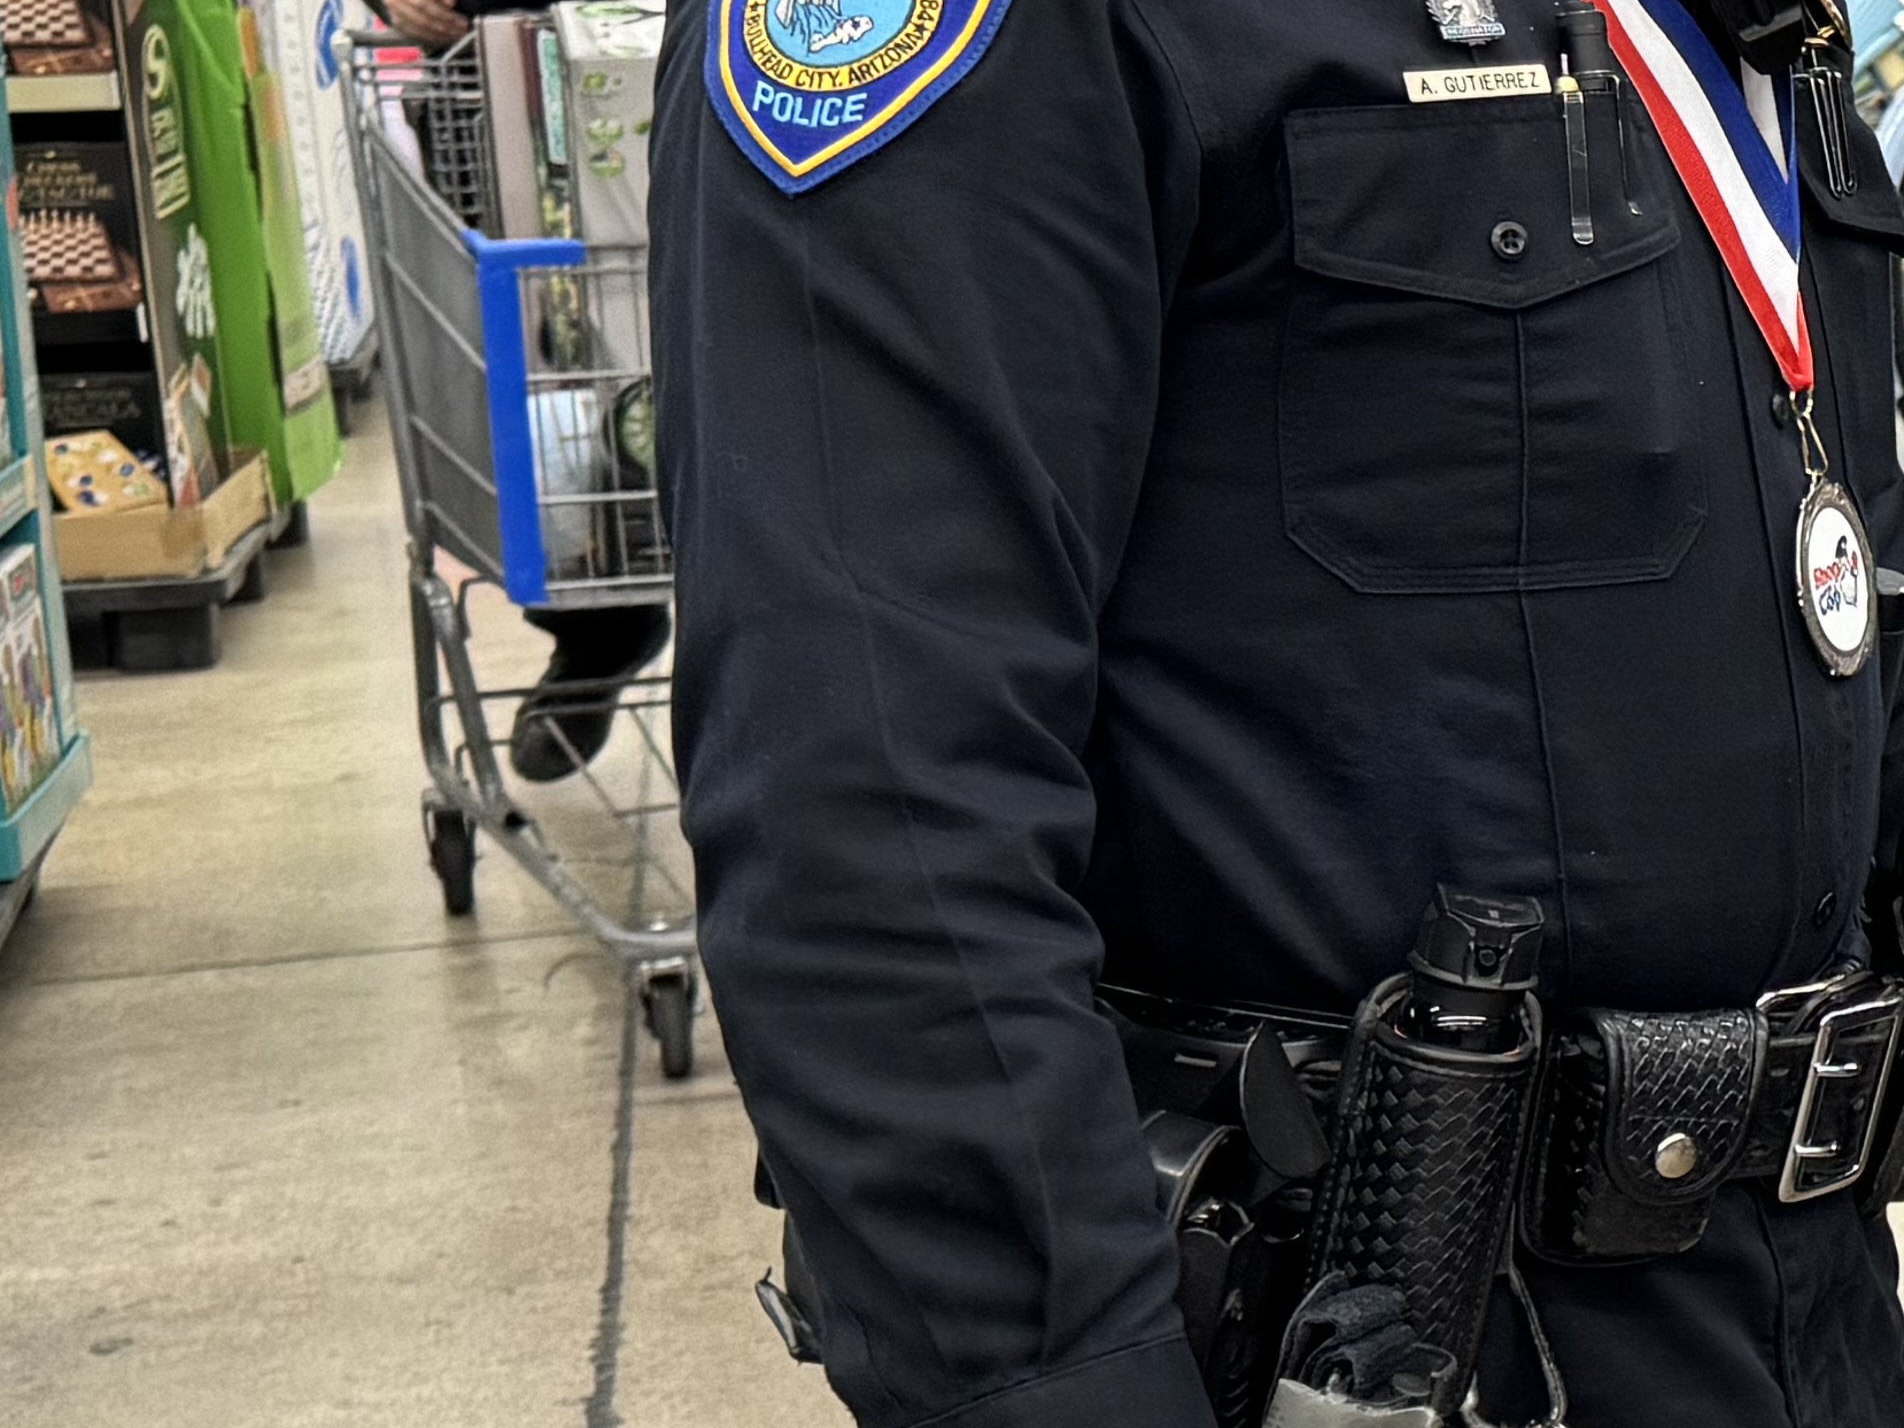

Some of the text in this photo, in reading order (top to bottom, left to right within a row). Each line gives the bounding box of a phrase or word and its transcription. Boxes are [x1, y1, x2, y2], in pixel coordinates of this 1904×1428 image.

[746, 15, 794, 81] BULLHEAD
[848, 30, 922, 85] ARIZONA
[753, 80, 868, 128] POLICE
[1420, 71, 1541, 95] A. GUTIERREZ
